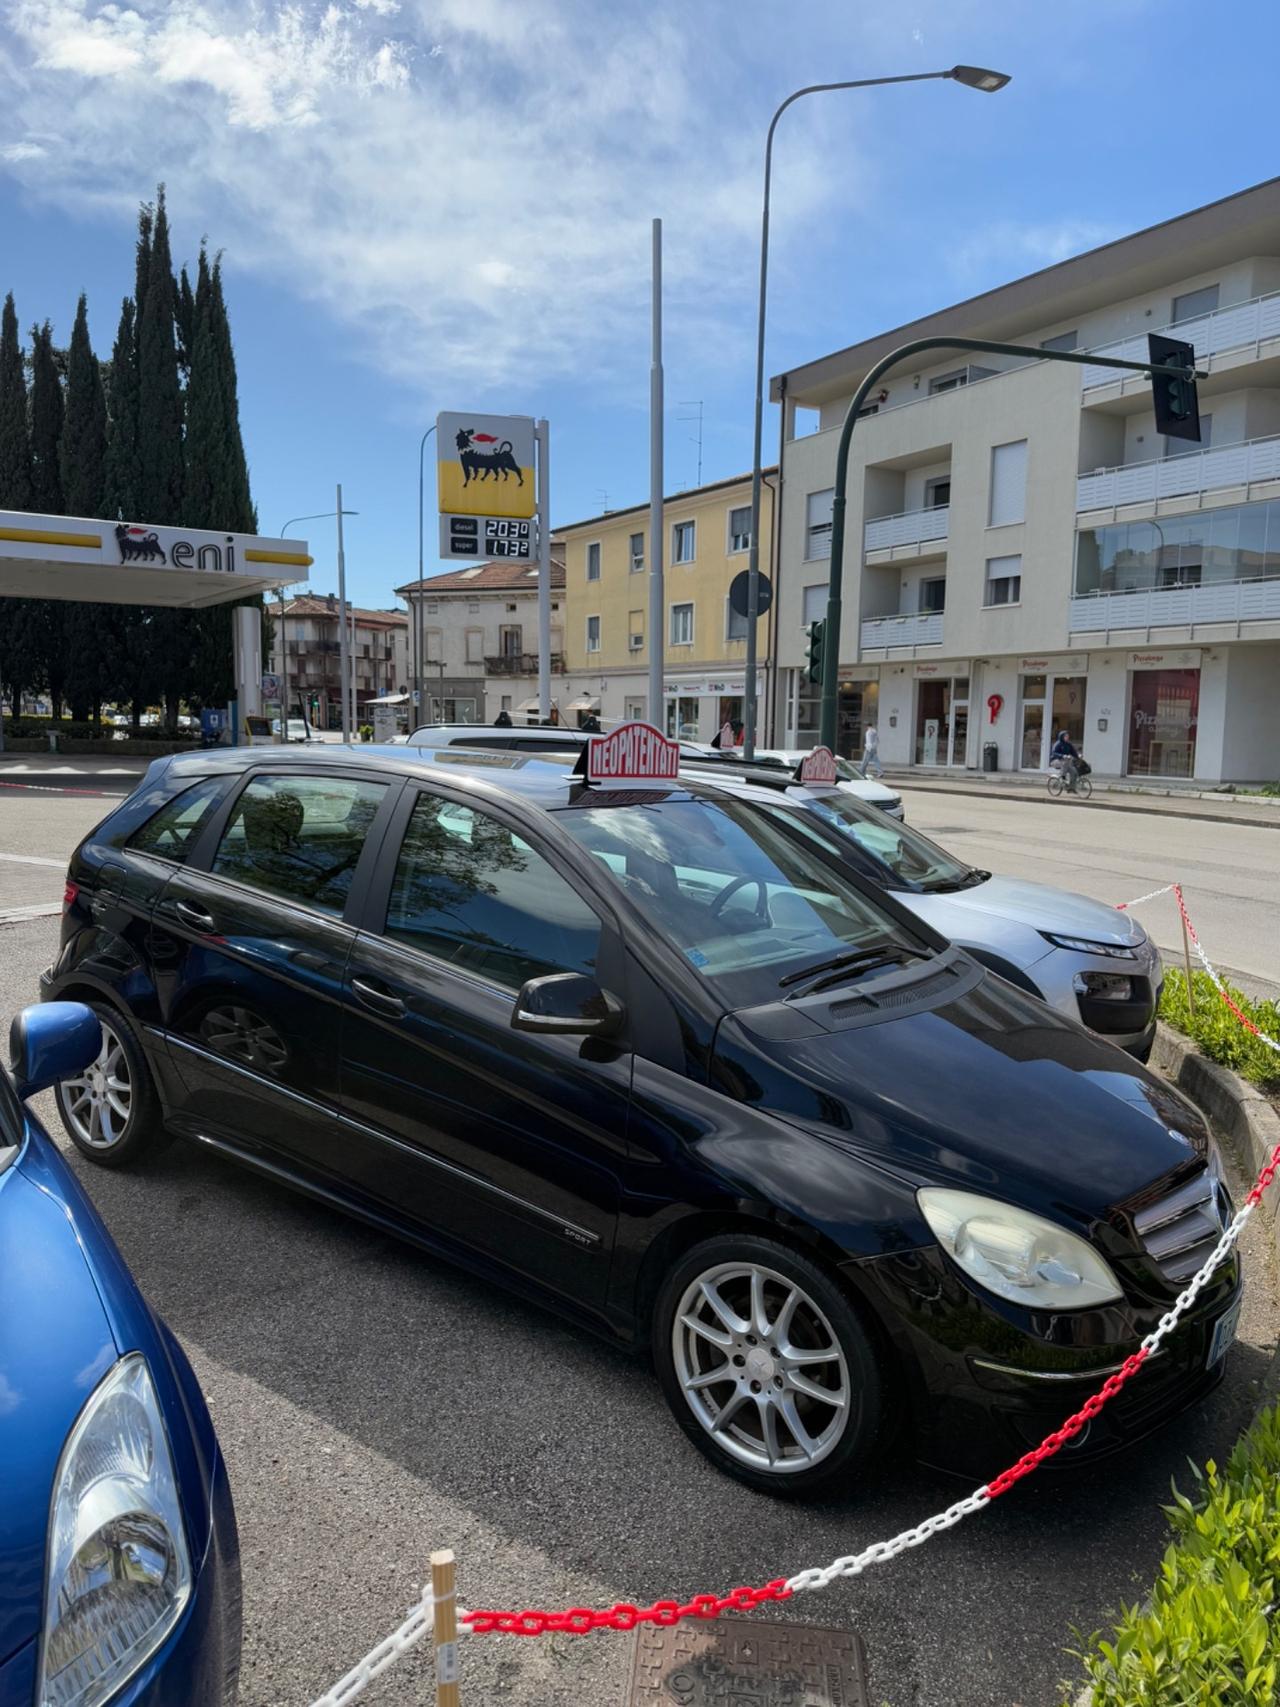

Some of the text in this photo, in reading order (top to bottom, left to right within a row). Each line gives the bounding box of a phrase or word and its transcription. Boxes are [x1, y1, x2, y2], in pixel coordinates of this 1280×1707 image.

[171, 535, 235, 572] eni
[593, 726, 677, 775] NEOPATENTATI
[565, 1228, 591, 1245] SPORT
